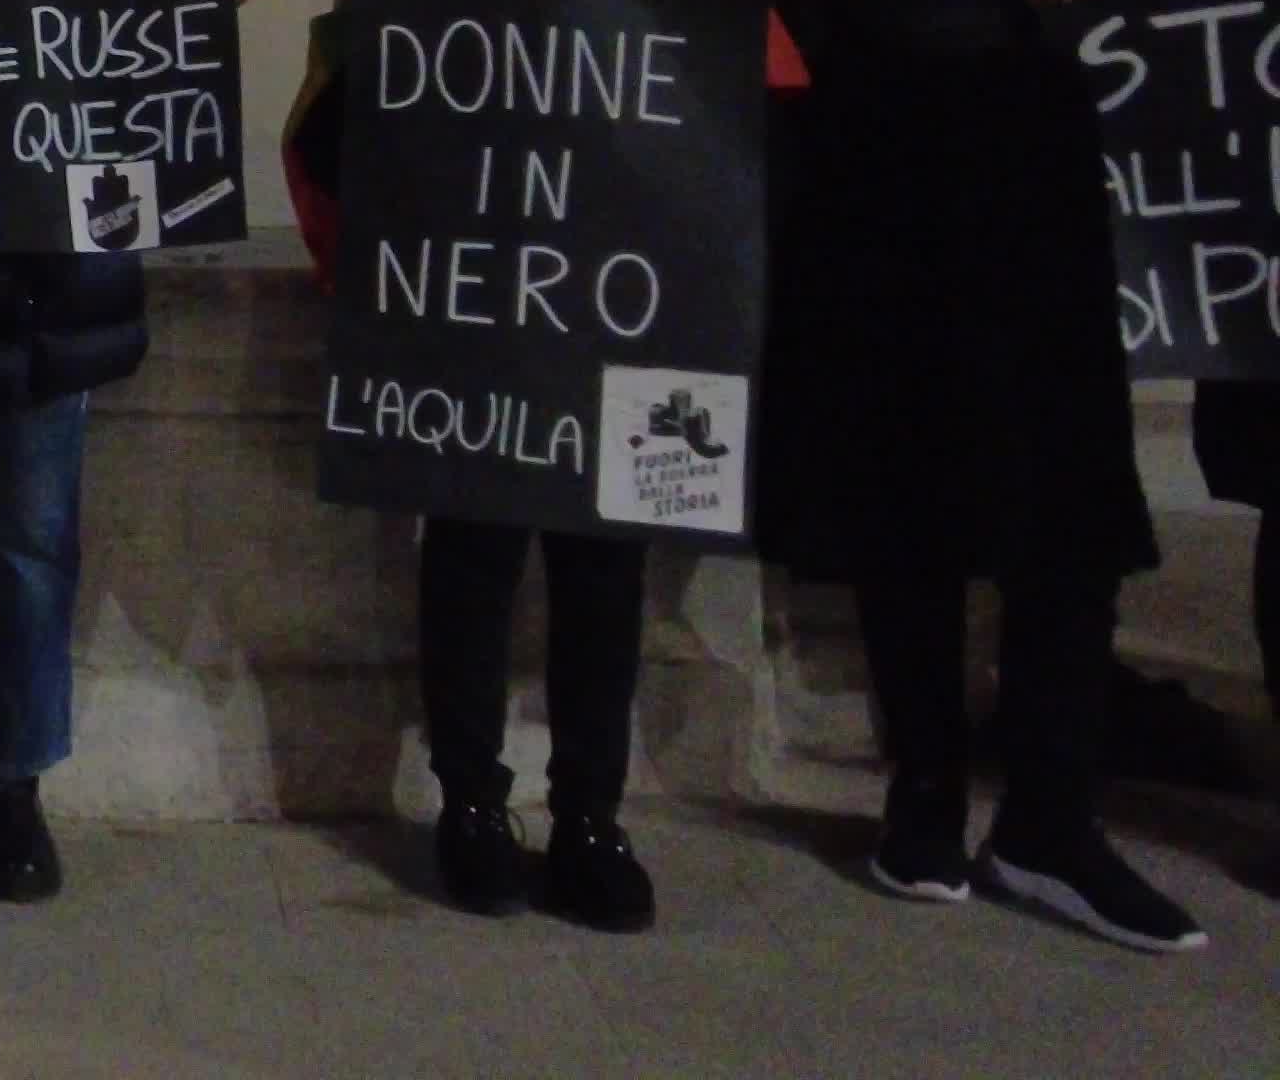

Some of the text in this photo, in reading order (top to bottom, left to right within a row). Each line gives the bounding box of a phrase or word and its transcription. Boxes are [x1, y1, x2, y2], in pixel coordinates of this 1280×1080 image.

[32, 2, 222, 81] RUSSE
[379, 20, 687, 125] DONNE
[14, 88, 224, 173] QUESTA
[478, 146, 573, 220] IN
[378, 237, 660, 337] NERO
[1193, 242, 1280, 346] P
[326, 376, 583, 474] L'AQUILA
